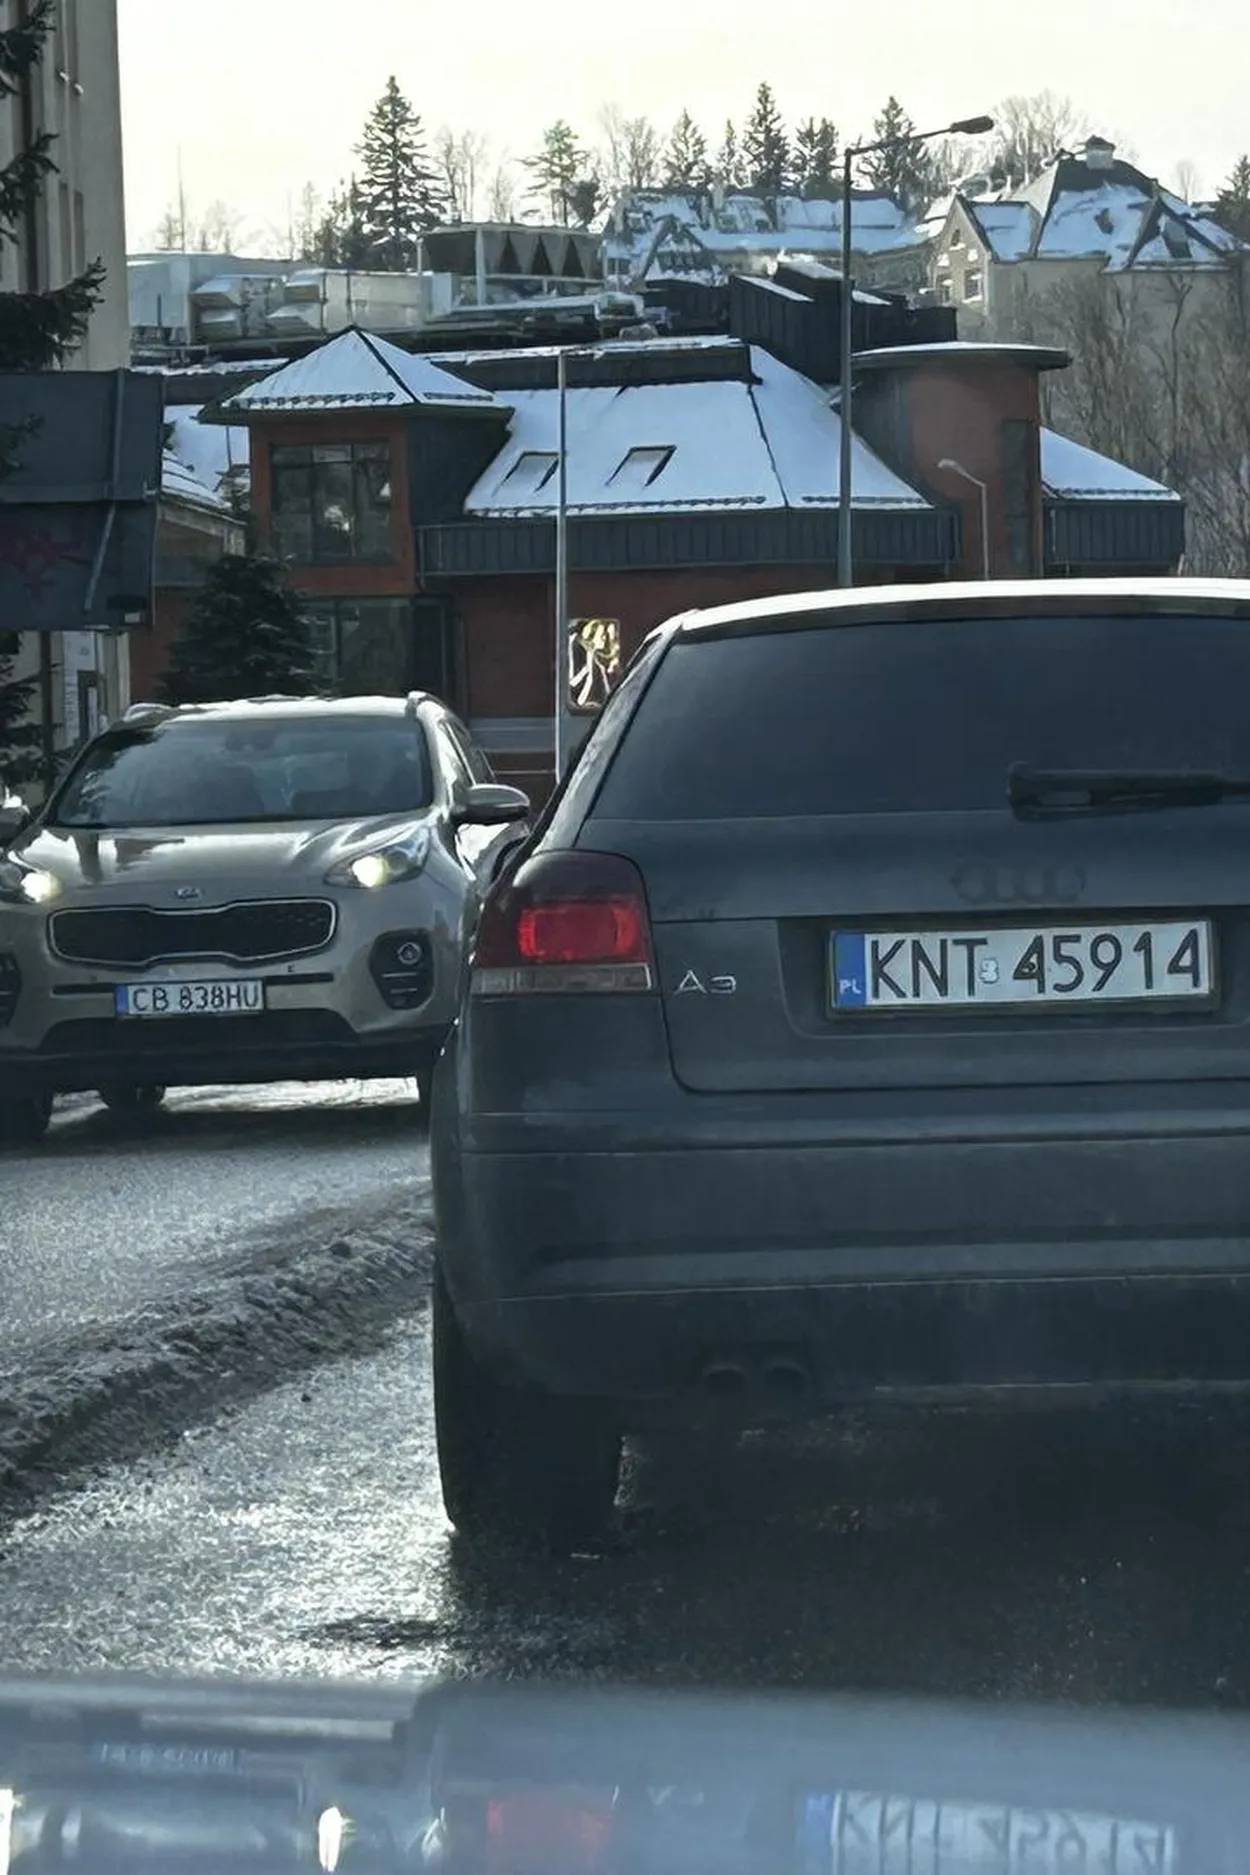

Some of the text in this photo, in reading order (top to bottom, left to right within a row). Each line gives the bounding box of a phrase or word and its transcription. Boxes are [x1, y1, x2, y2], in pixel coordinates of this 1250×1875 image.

[870, 928, 1201, 999] KNT 45914
[673, 969, 737, 995] A3
[839, 978, 863, 995] PL
[132, 982, 259, 1012] CB 838HU
